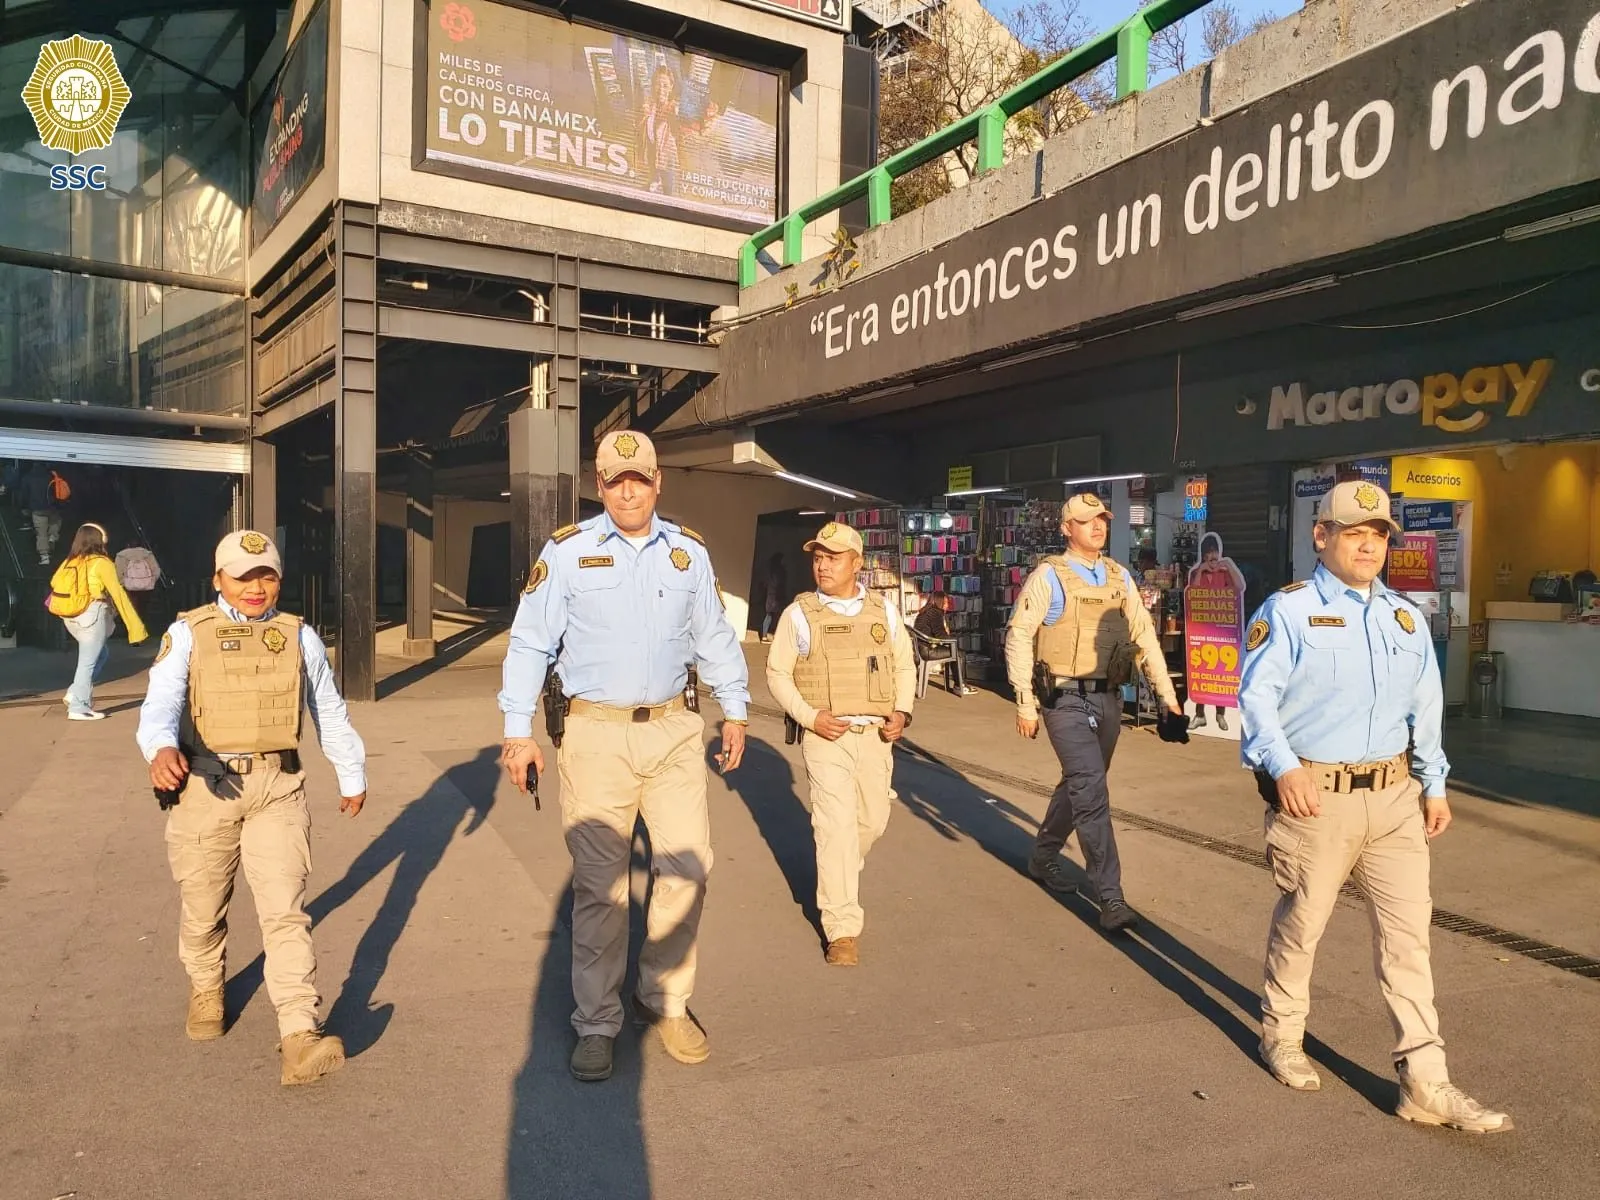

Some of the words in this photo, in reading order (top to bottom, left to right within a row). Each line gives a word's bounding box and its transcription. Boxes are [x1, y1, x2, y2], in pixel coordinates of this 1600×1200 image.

[439, 52, 481, 72] MILES
[485, 63, 503, 77] DE
[439, 68, 503, 92] CAJEROS
[506, 84, 554, 106] CERCA,
[439, 85, 485, 110] CON
[493, 96, 602, 138] BANAMEX,
[269, 92, 309, 165] EXPANDING
[438, 107, 487, 146] LO
[499, 120, 635, 177] TIENES.
[681, 182, 689, 194] Y
[716, 178, 729, 188] TU
[731, 181, 770, 198] CUENTA
[890, 223, 1078, 336] entonces
[1097, 192, 1162, 266] un
[1184, 99, 1395, 235] delito
[1266, 358, 1553, 431] Macropay
[1406, 470, 1461, 486] Accesorios
[1393, 551, 1428, 569] 50%
[1190, 643, 1238, 672] $99
[1191, 681, 1199, 691] A
